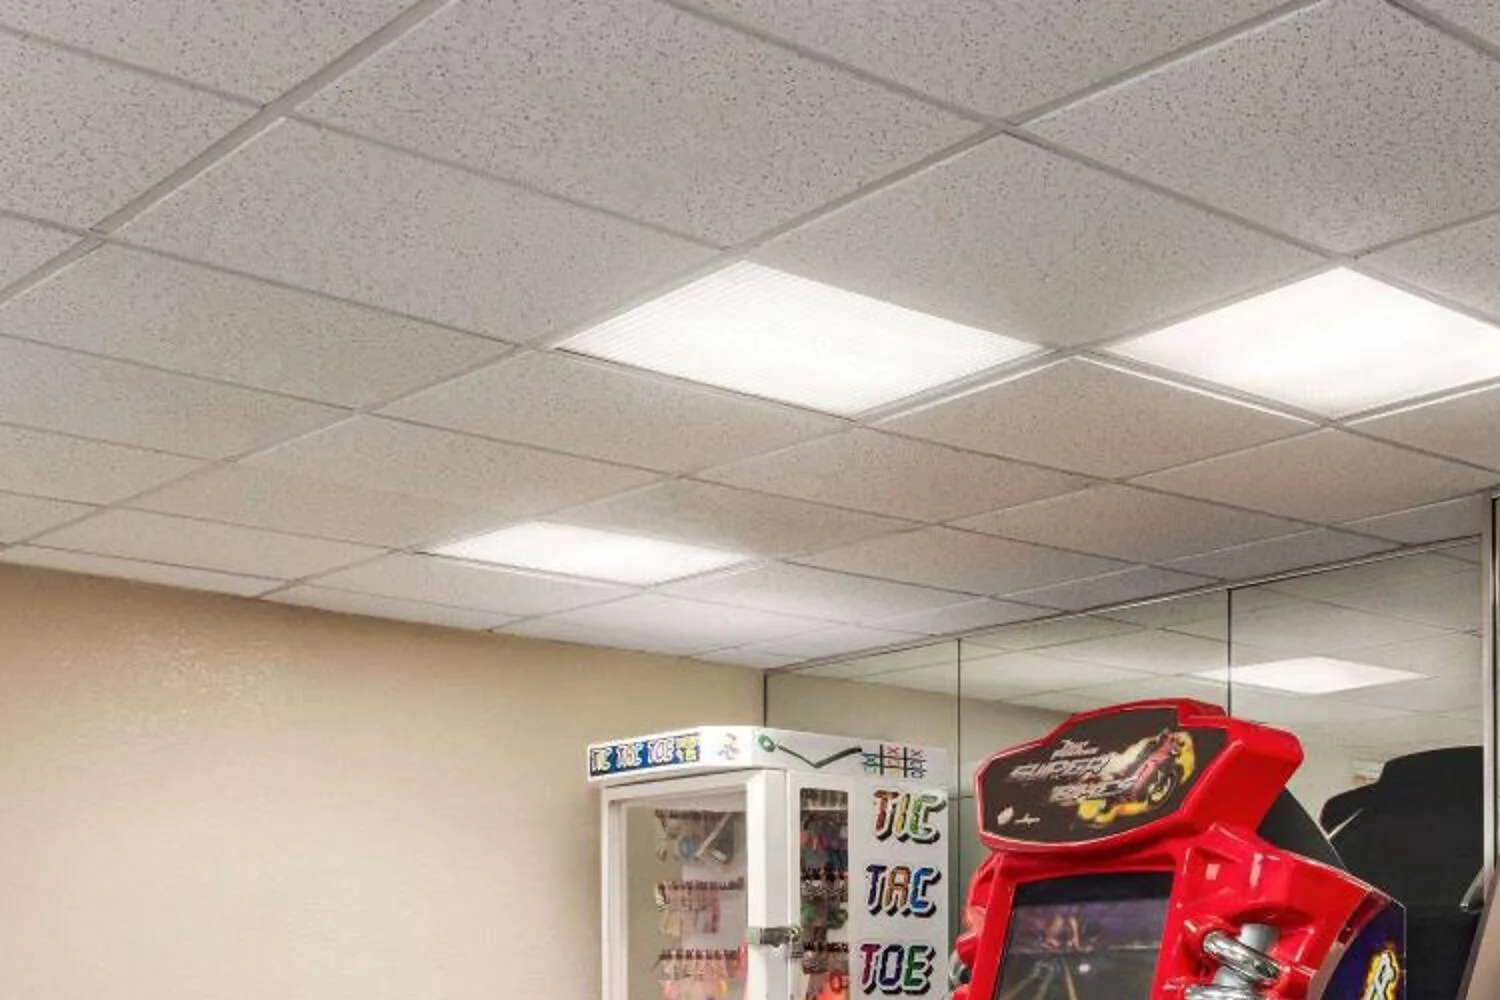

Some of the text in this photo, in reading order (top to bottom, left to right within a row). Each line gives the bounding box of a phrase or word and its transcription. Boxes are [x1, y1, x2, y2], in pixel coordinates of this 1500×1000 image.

[873, 789, 946, 844] TIC
[865, 864, 942, 917] TAC
[859, 943, 937, 995] TOE
